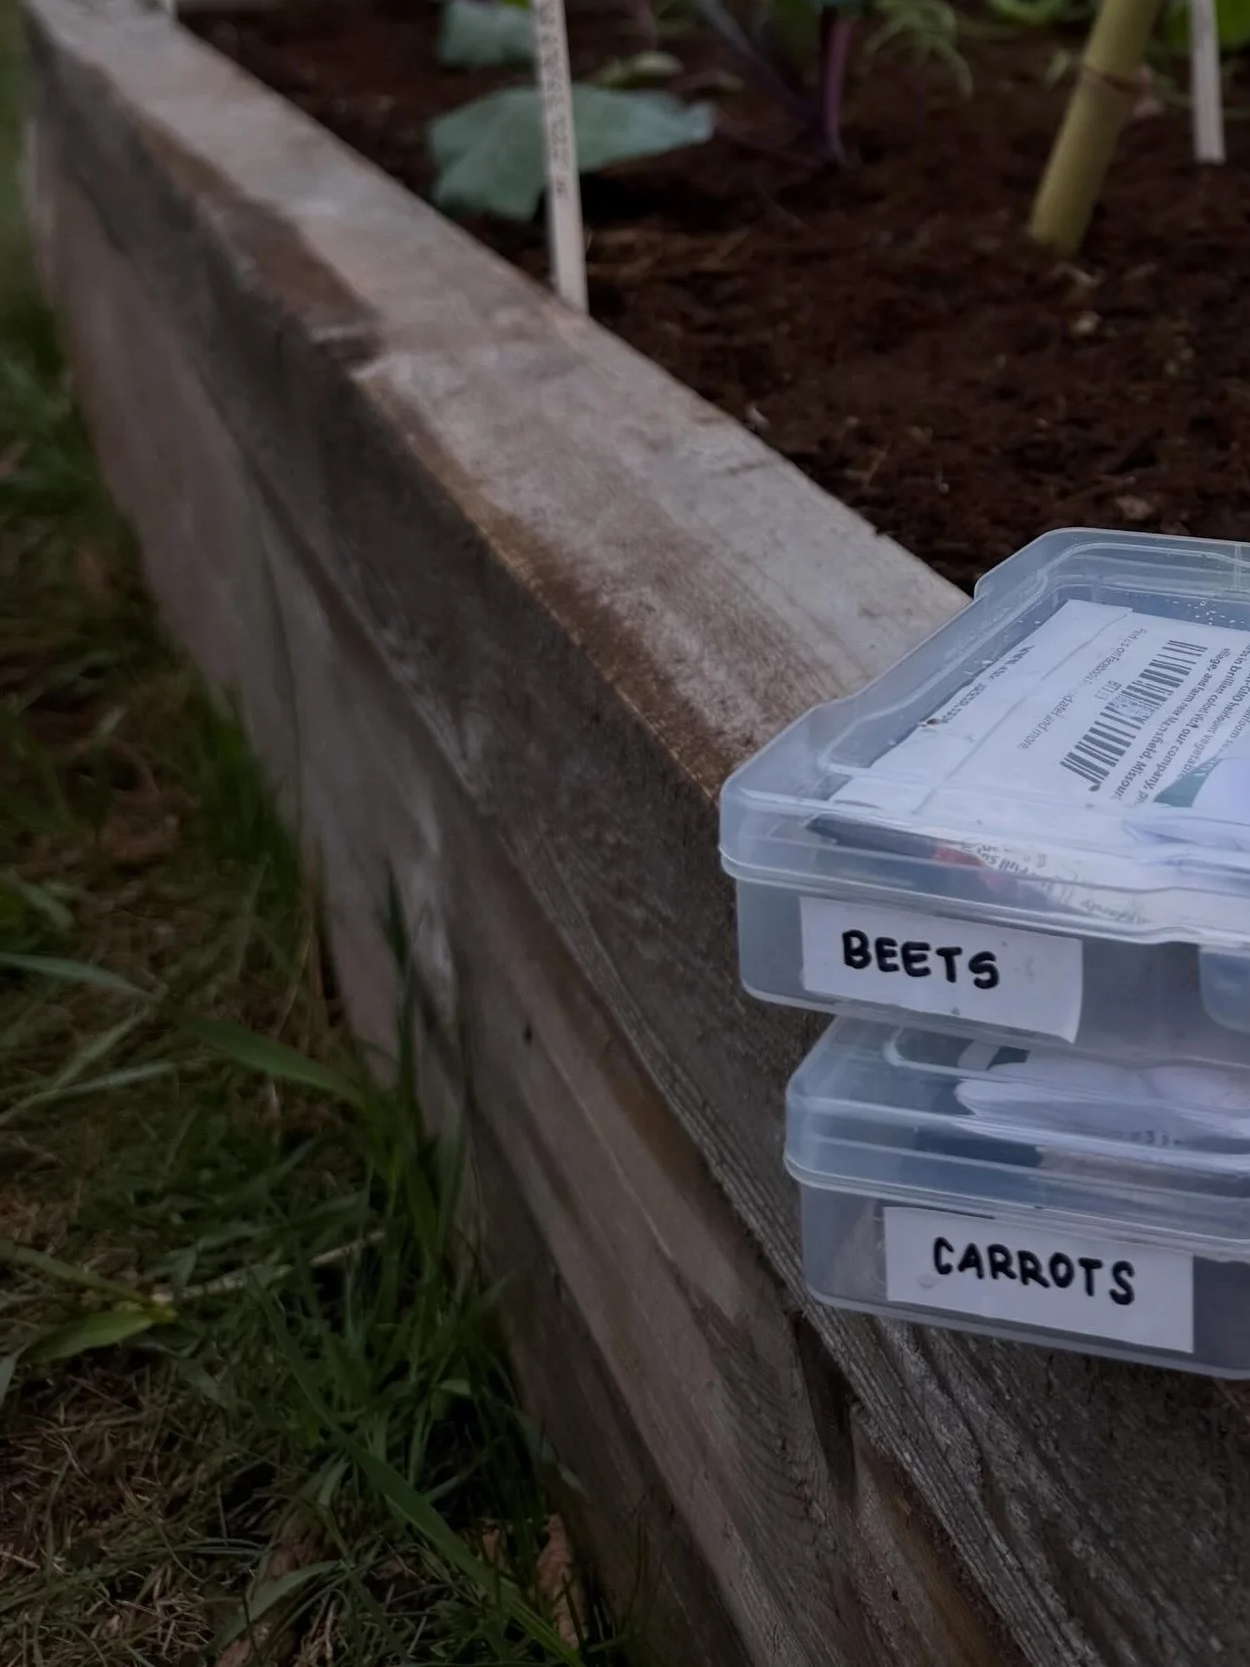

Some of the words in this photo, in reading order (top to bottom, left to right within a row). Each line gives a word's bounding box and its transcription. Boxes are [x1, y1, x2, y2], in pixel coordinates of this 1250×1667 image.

[1175, 727, 1191, 745] our
[1143, 745, 1179, 790] company,
[843, 930, 998, 989] BEETS
[932, 1236, 1135, 1306] CARROTS
